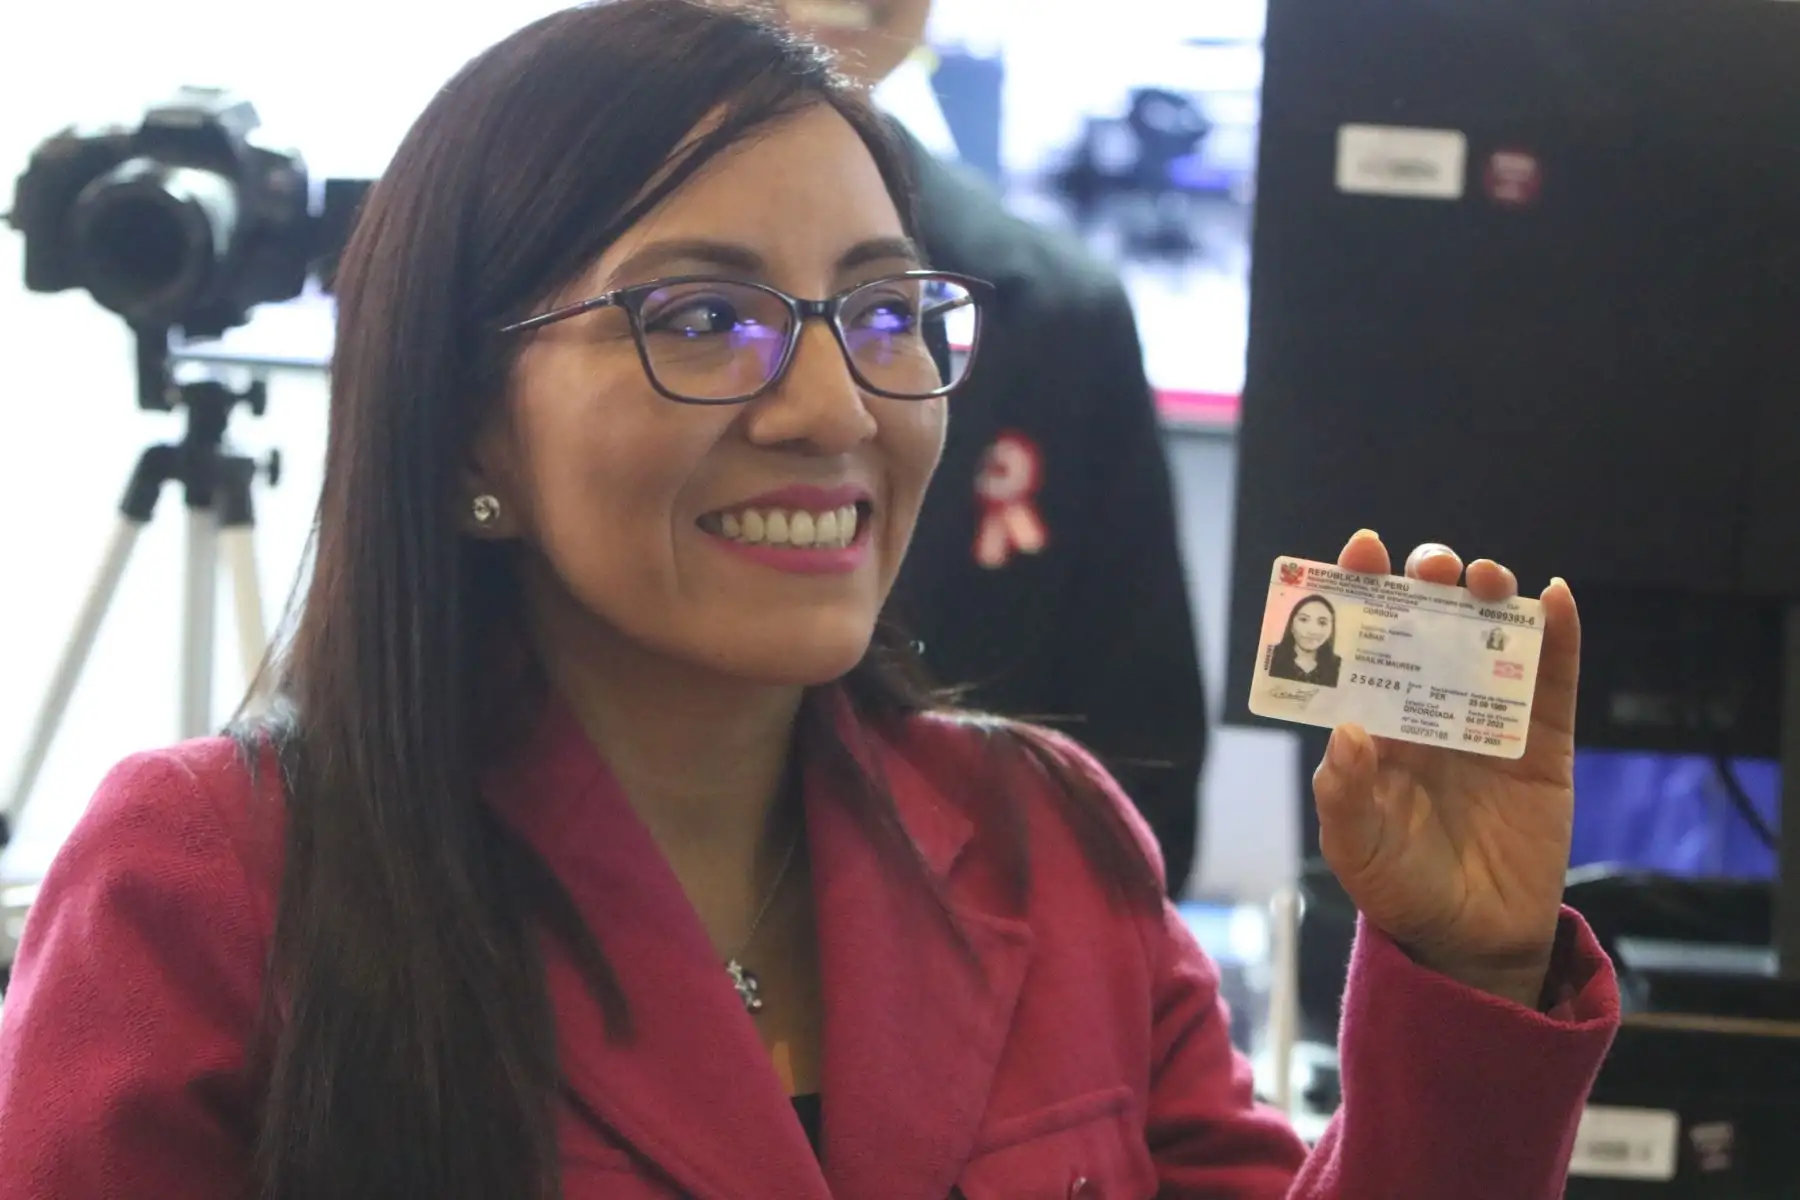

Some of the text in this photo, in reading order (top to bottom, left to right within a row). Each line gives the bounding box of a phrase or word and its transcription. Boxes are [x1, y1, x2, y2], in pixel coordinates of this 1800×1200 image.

[1308, 567, 1362, 583] REPÚBLICA
[1363, 578, 1382, 586] DEL
[1404, 706, 1455, 720] DIVORCIADA
